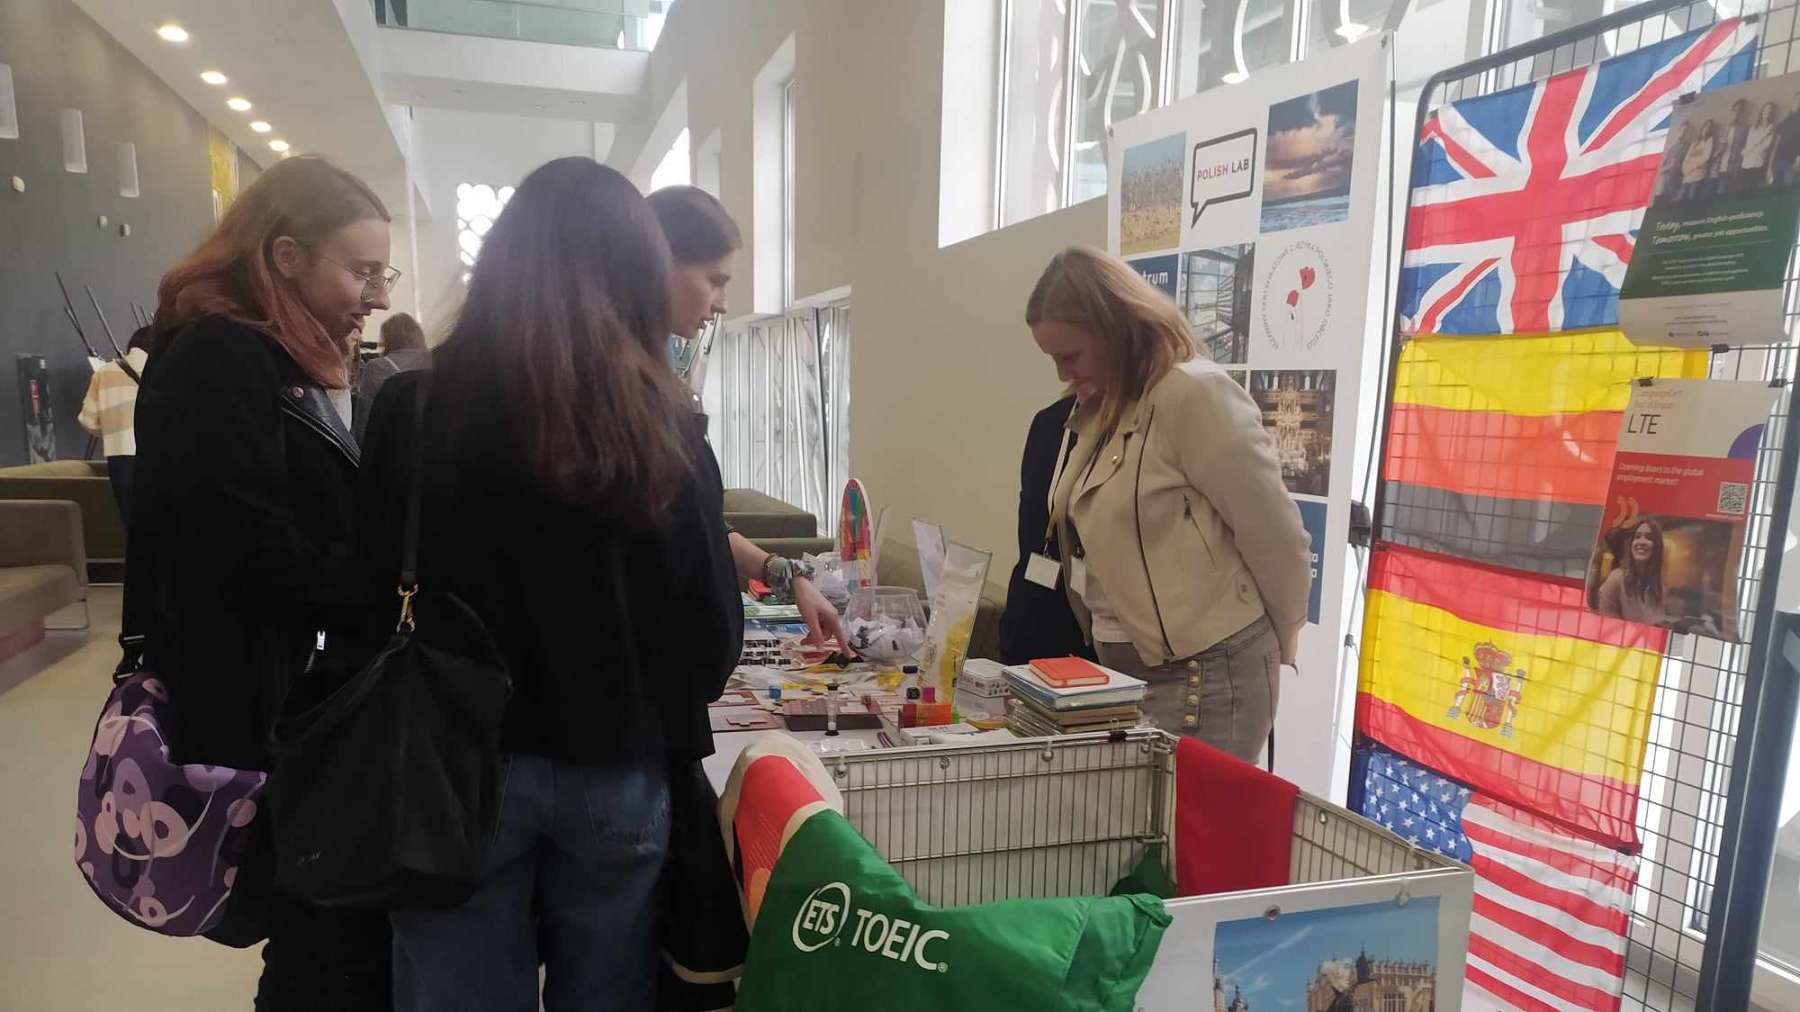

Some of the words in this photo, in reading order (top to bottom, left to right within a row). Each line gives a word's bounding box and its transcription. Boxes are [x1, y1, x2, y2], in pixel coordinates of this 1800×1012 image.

[1197, 163, 1229, 182] POLISH
[1231, 158, 1250, 173] LAB
[1627, 413, 1662, 435] LTE
[802, 899, 840, 935] ETS
